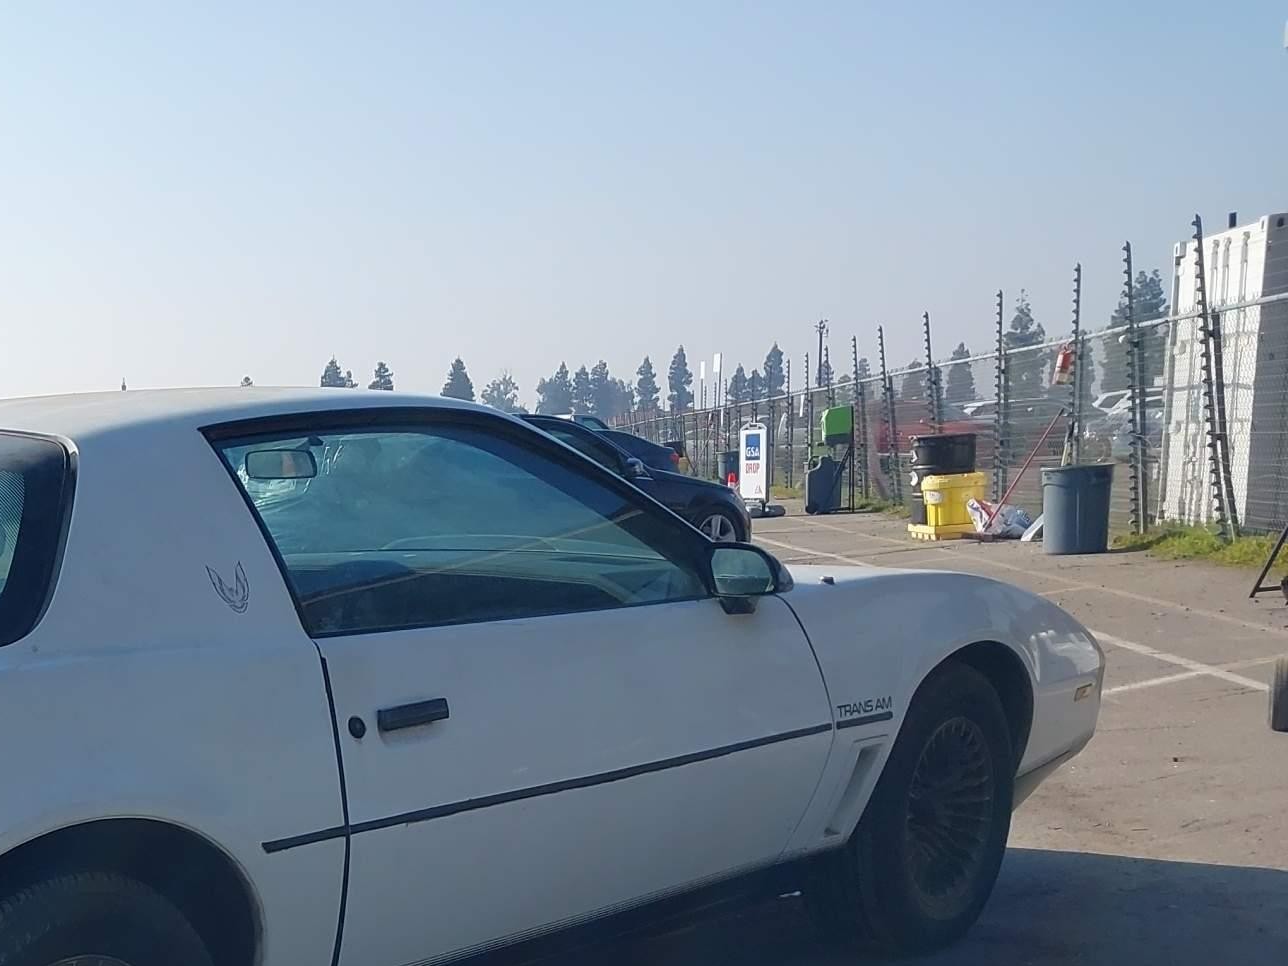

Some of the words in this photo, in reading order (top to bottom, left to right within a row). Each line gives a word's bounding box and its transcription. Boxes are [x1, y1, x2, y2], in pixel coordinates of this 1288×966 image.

[745, 446, 760, 457] GSA
[745, 462, 760, 474] DROP
[837, 699, 874, 718] TRANS
[875, 695, 893, 711] AM
